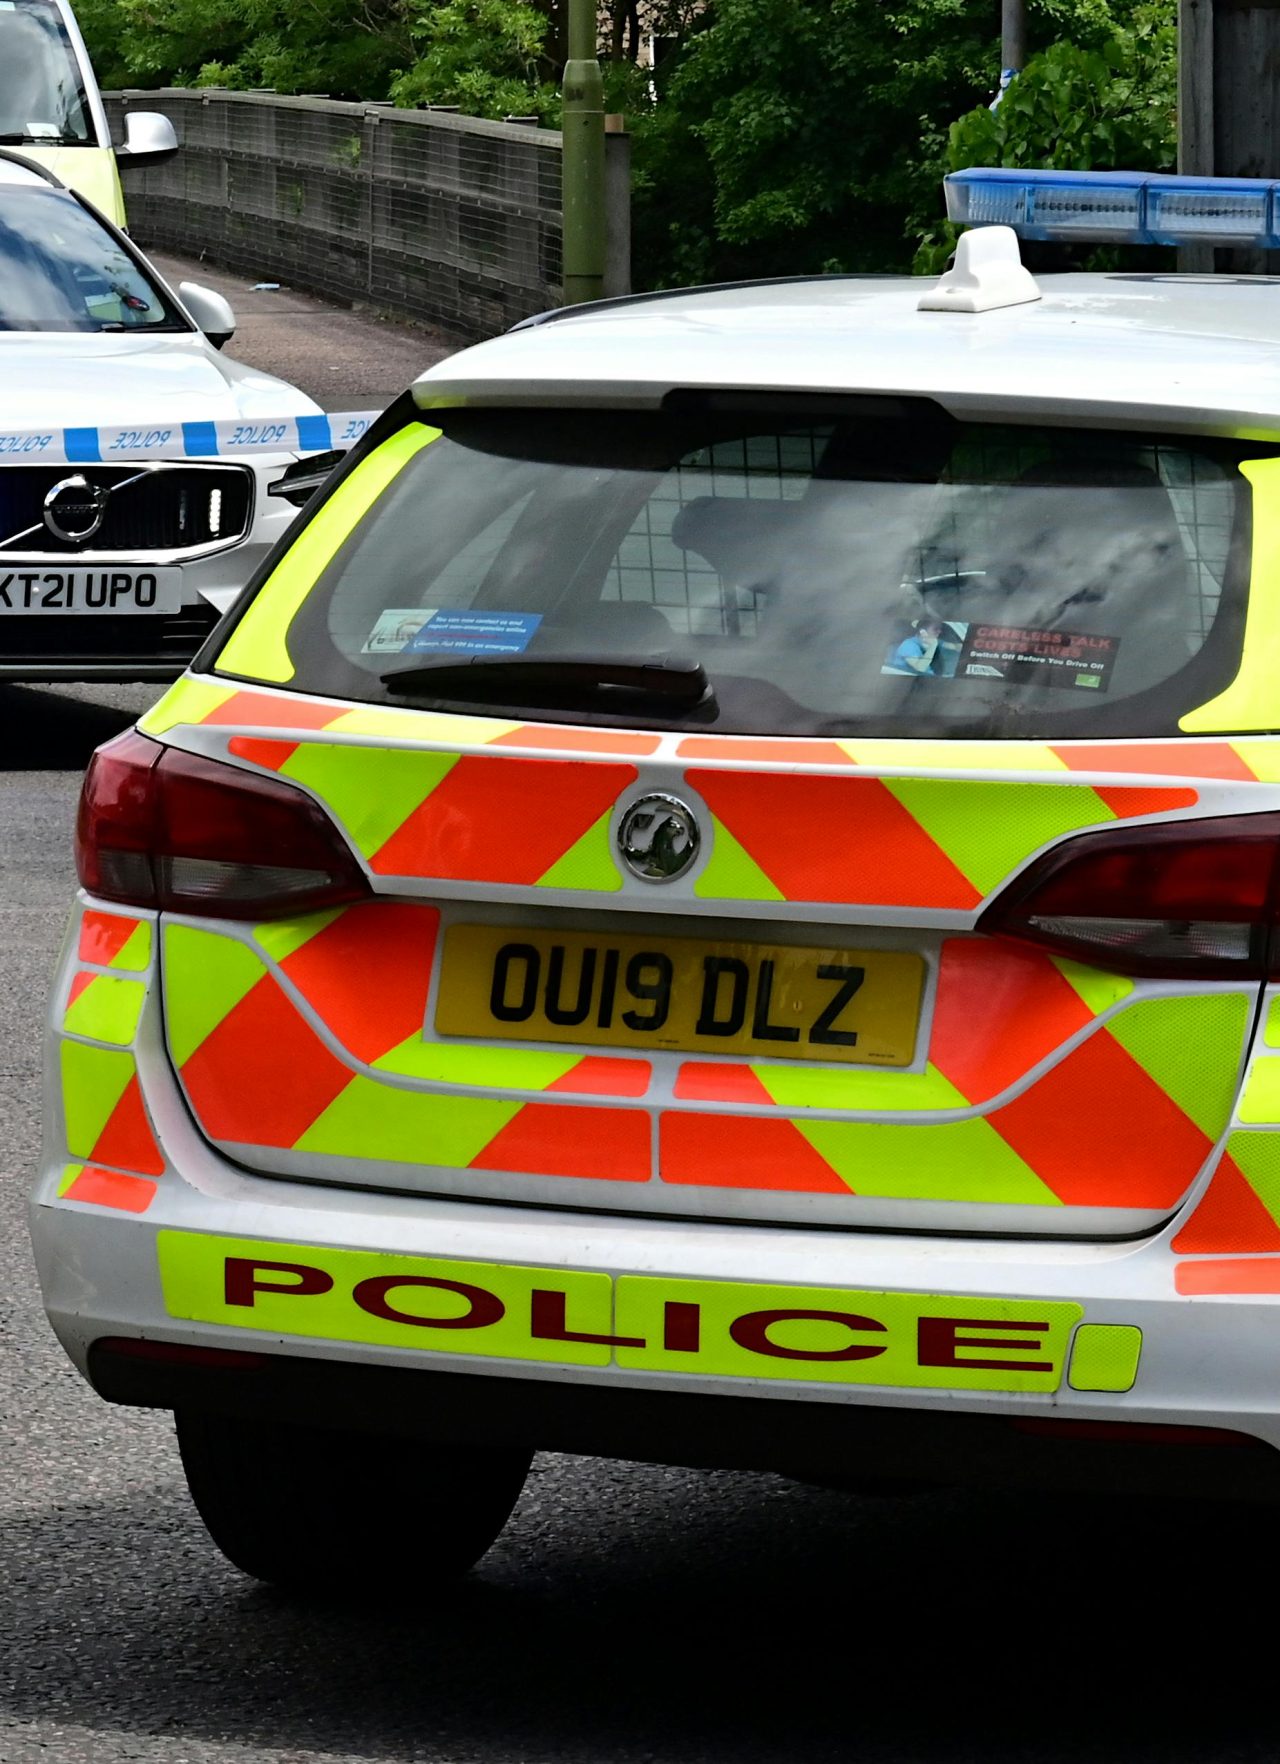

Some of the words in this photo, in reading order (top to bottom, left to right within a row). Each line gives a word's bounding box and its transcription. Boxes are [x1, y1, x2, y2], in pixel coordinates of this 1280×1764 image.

[0, 573, 75, 607] KT21
[85, 573, 157, 607] UPO
[973, 638, 1028, 654] COSTS
[976, 627, 1063, 644] CARELESS
[1070, 635, 1112, 649] TALK
[969, 651, 999, 660] Switch
[1001, 653, 1016, 661] Off
[1017, 655, 1046, 664] Before
[1066, 660, 1088, 668] Drive
[1090, 662, 1105, 670] Off
[490, 943, 674, 1032] OU19
[695, 955, 865, 1047] DLZ
[224, 1256, 1054, 1372] POLICE
